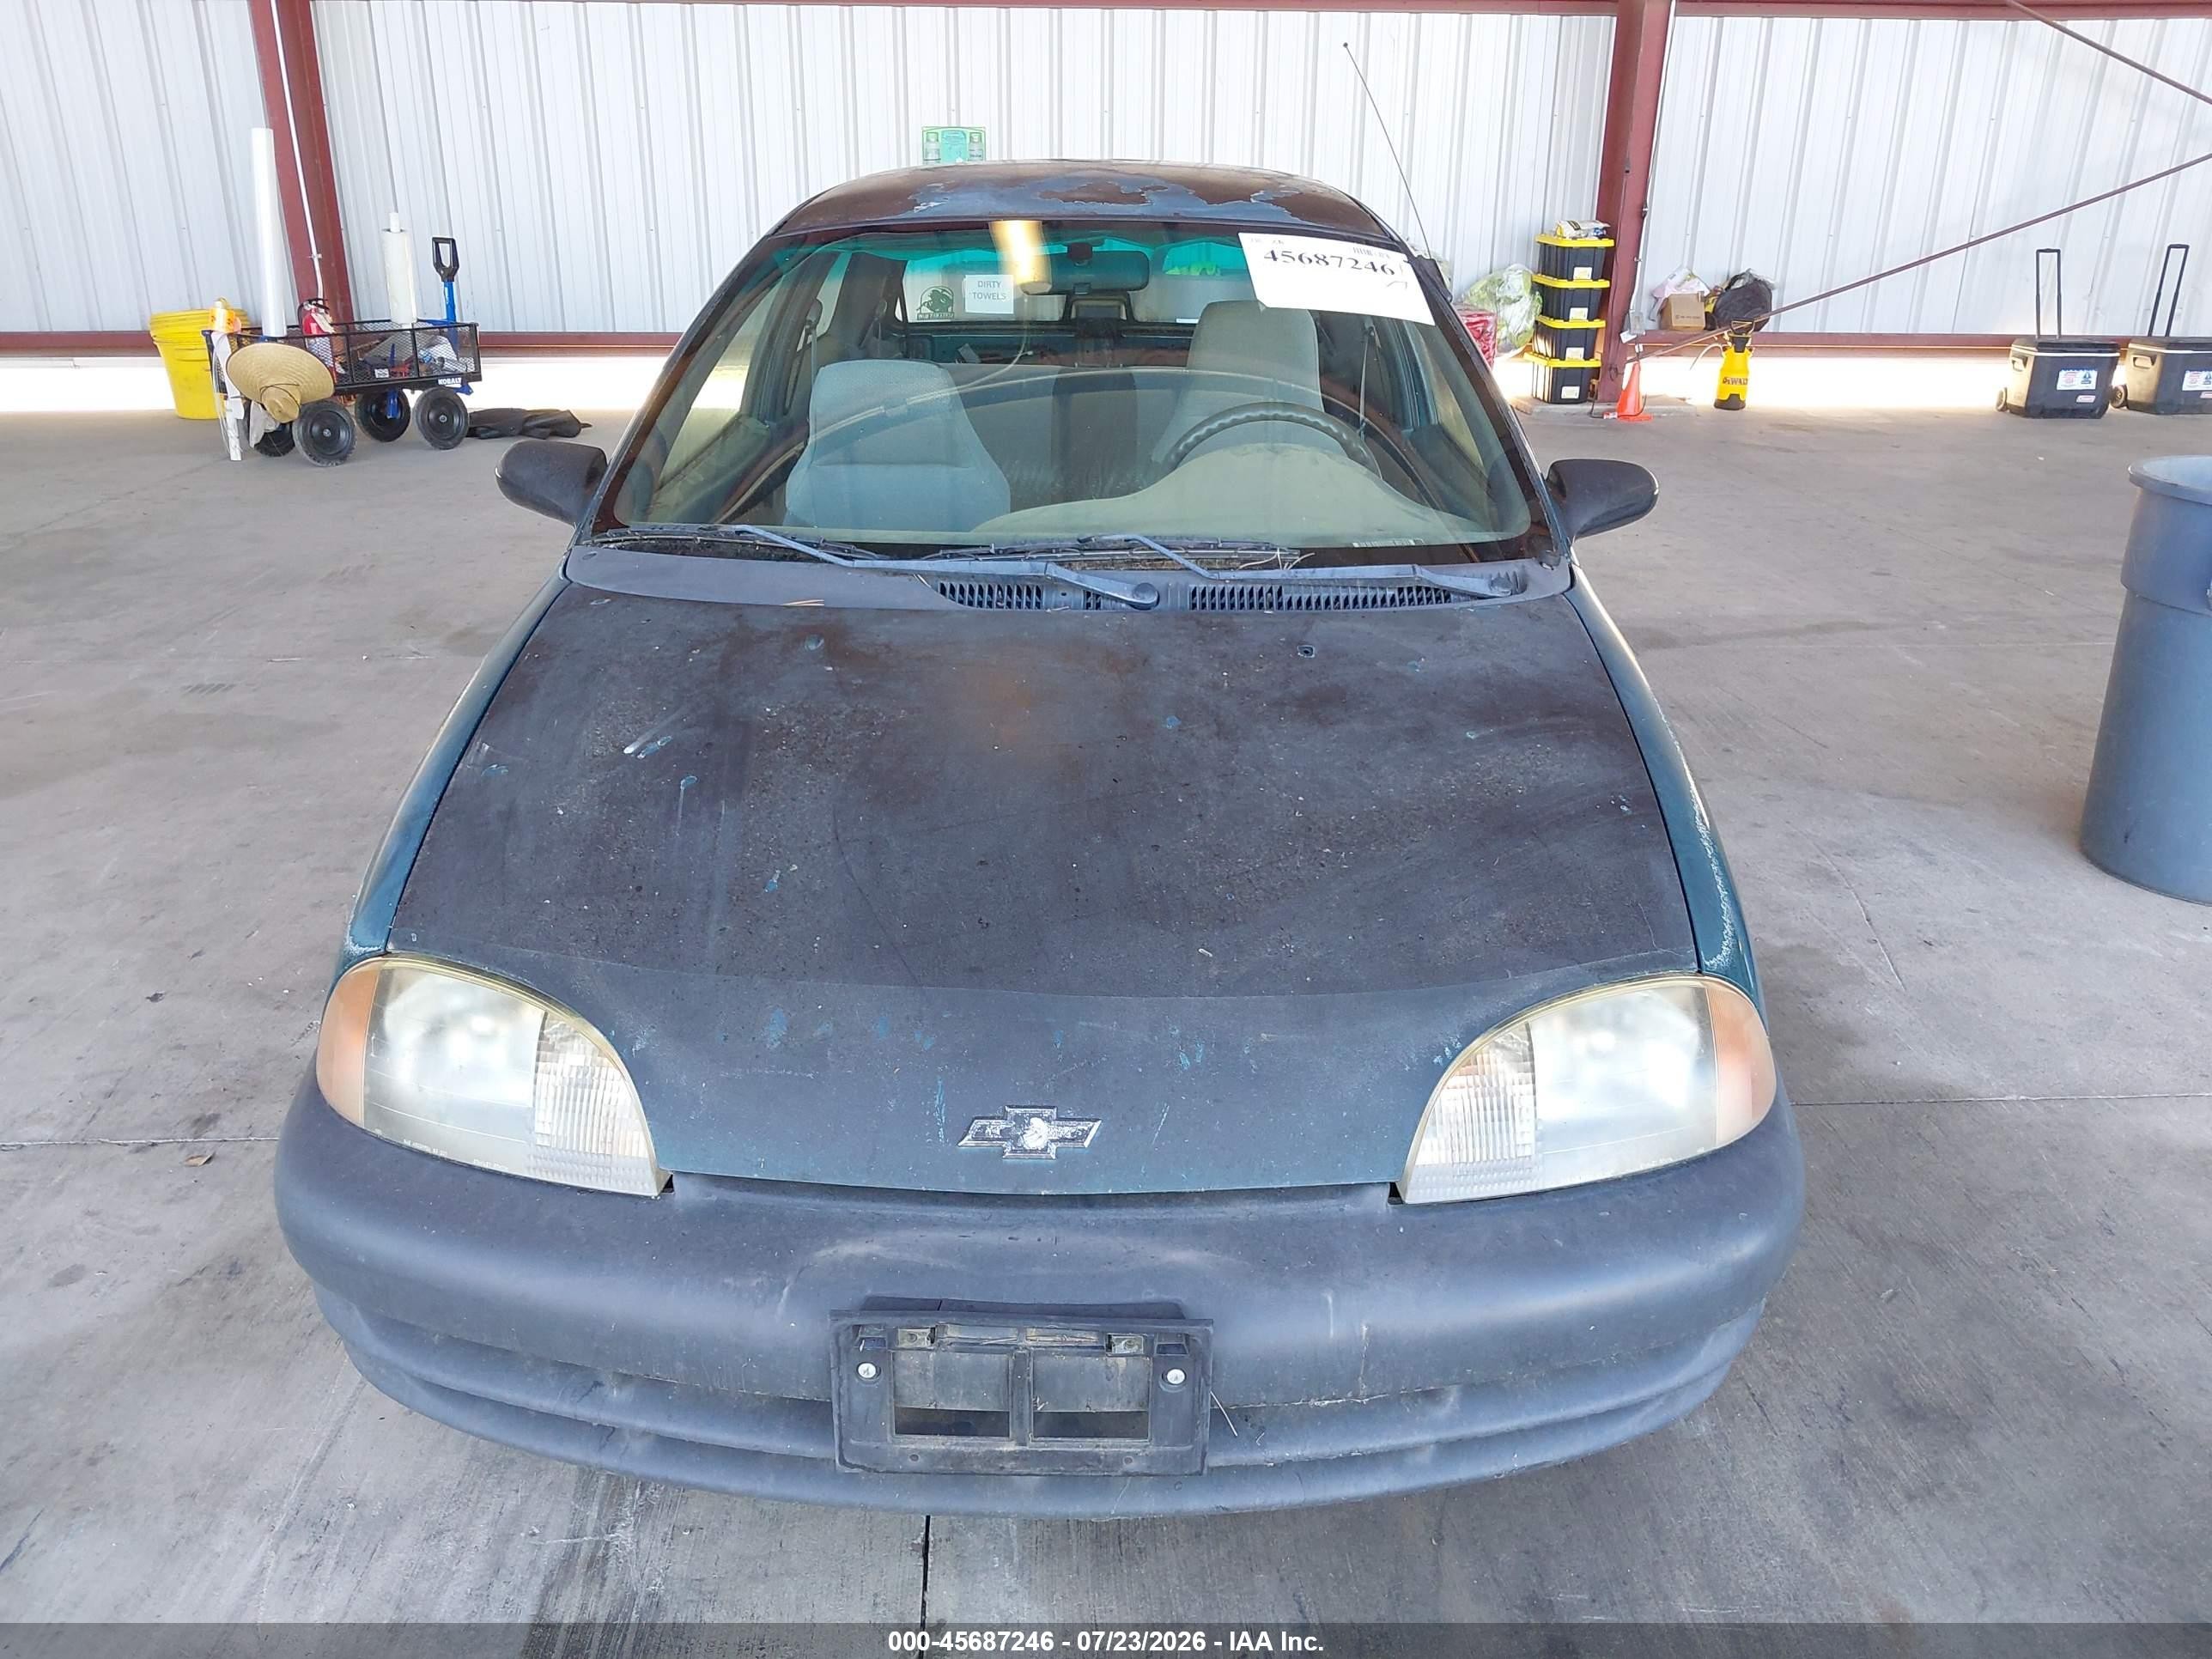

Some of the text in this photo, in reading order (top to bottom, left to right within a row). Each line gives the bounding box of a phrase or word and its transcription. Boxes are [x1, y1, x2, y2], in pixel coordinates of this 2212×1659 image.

[1263, 248, 1395, 276] 45687246
[977, 280, 1002, 289] DIRTY
[973, 291, 1006, 301] TOWELS
